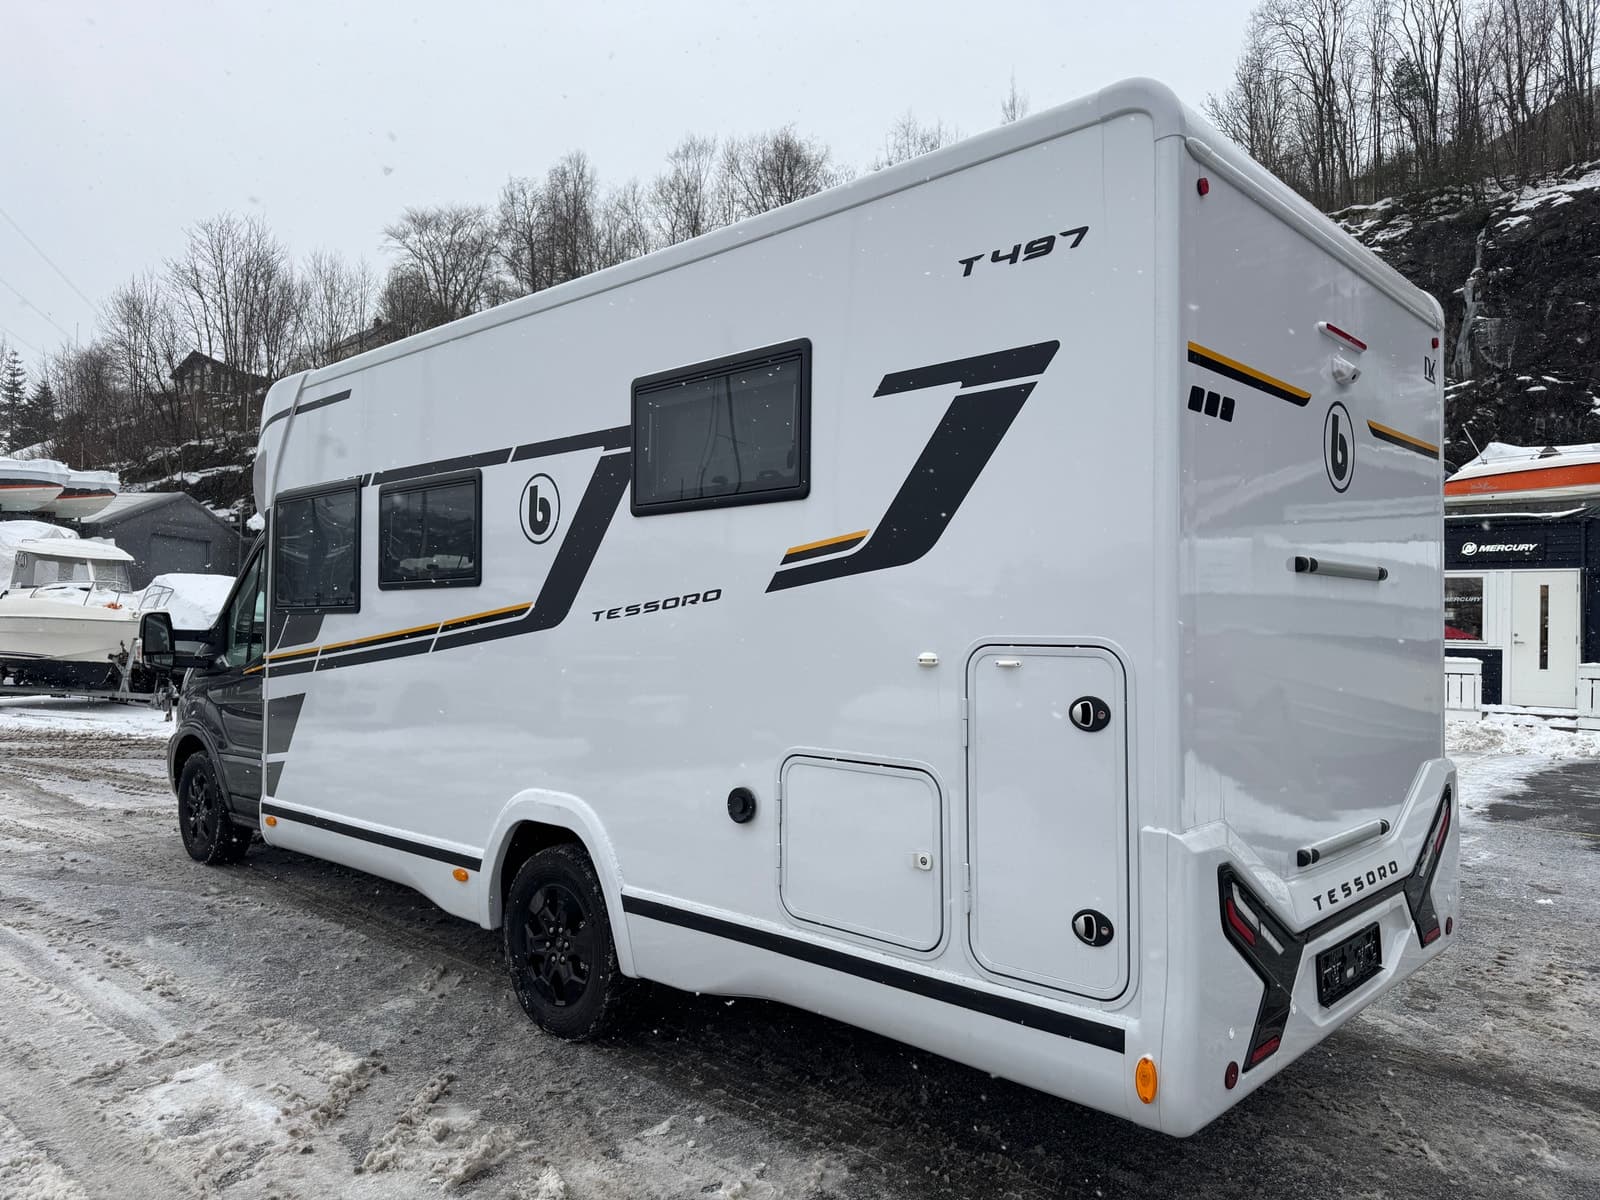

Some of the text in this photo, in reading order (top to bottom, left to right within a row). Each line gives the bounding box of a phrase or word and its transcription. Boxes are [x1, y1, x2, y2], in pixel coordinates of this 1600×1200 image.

[1478, 543, 1538, 553] MERCURY
[592, 589, 722, 622] TESSORO
[1312, 860, 1398, 911] TESSORO
